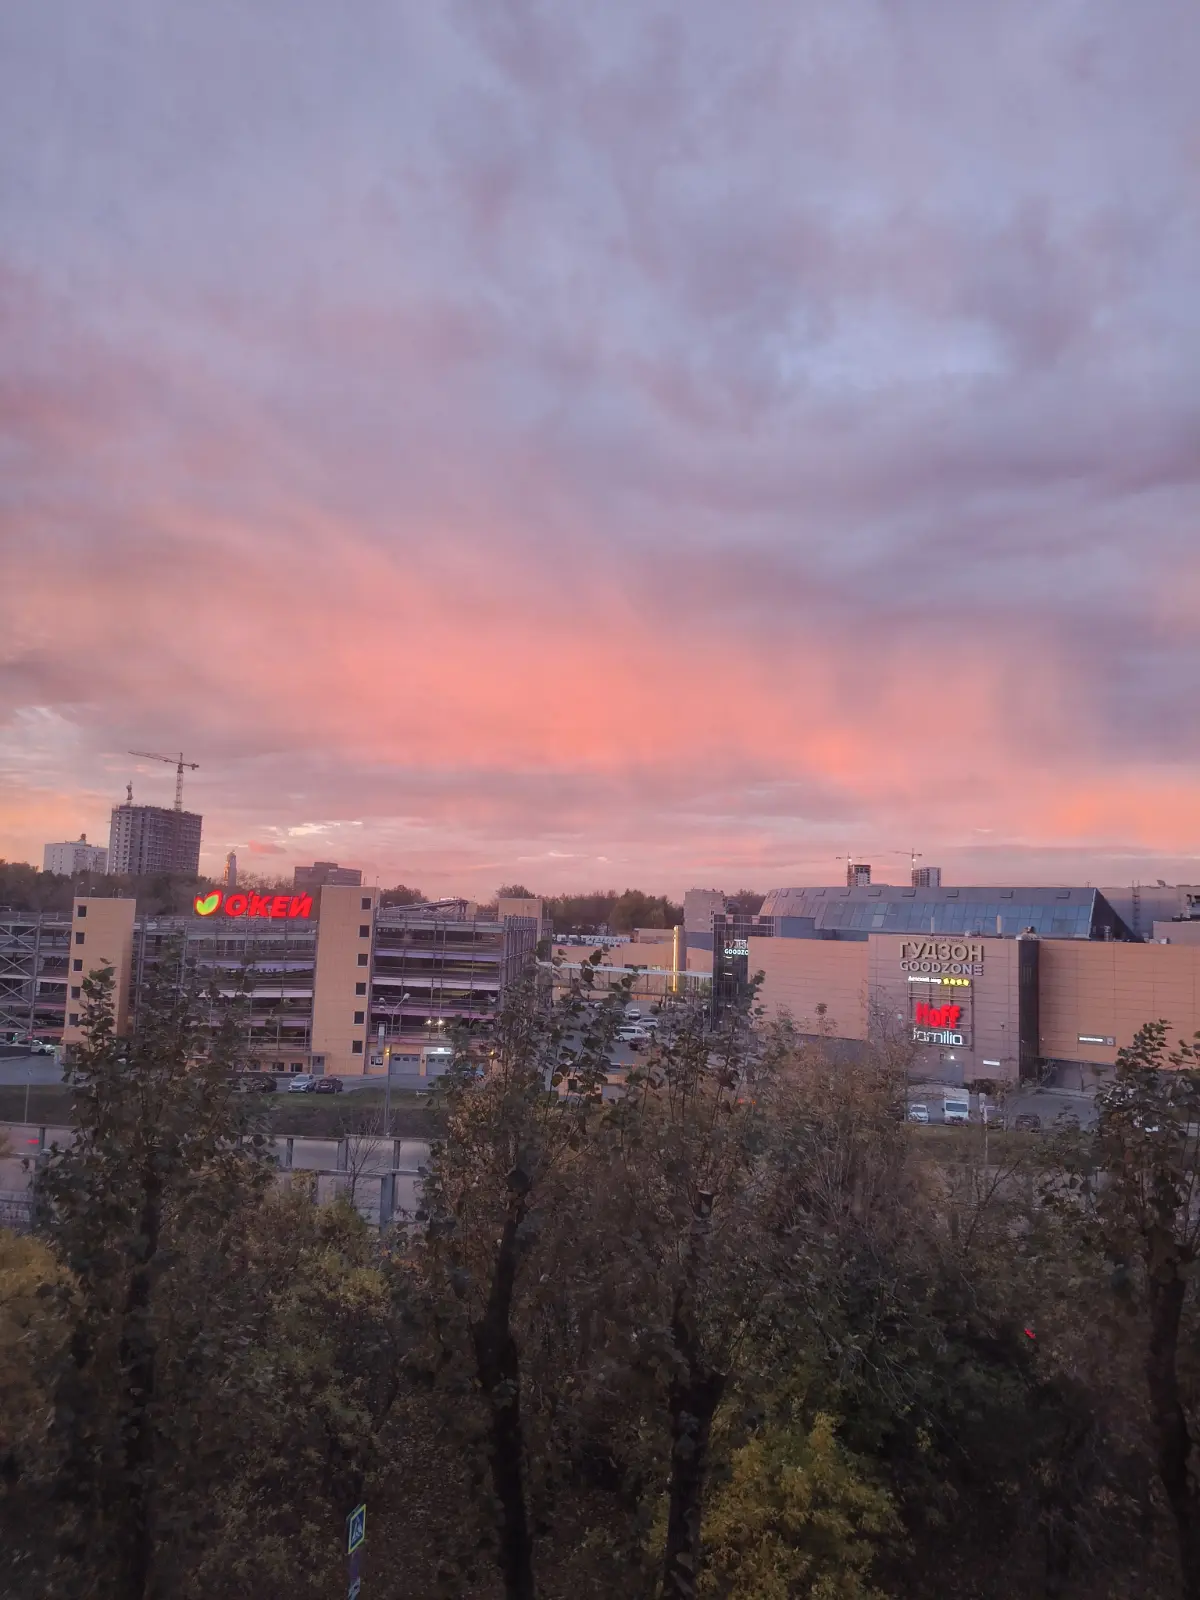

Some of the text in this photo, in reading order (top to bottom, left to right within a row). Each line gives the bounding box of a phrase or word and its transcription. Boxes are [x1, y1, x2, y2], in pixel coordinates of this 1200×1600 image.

[900, 941, 984, 962] ГУДЗОН
[900, 961, 984, 976] GOODZONE
[916, 1002, 960, 1029] Hoff
